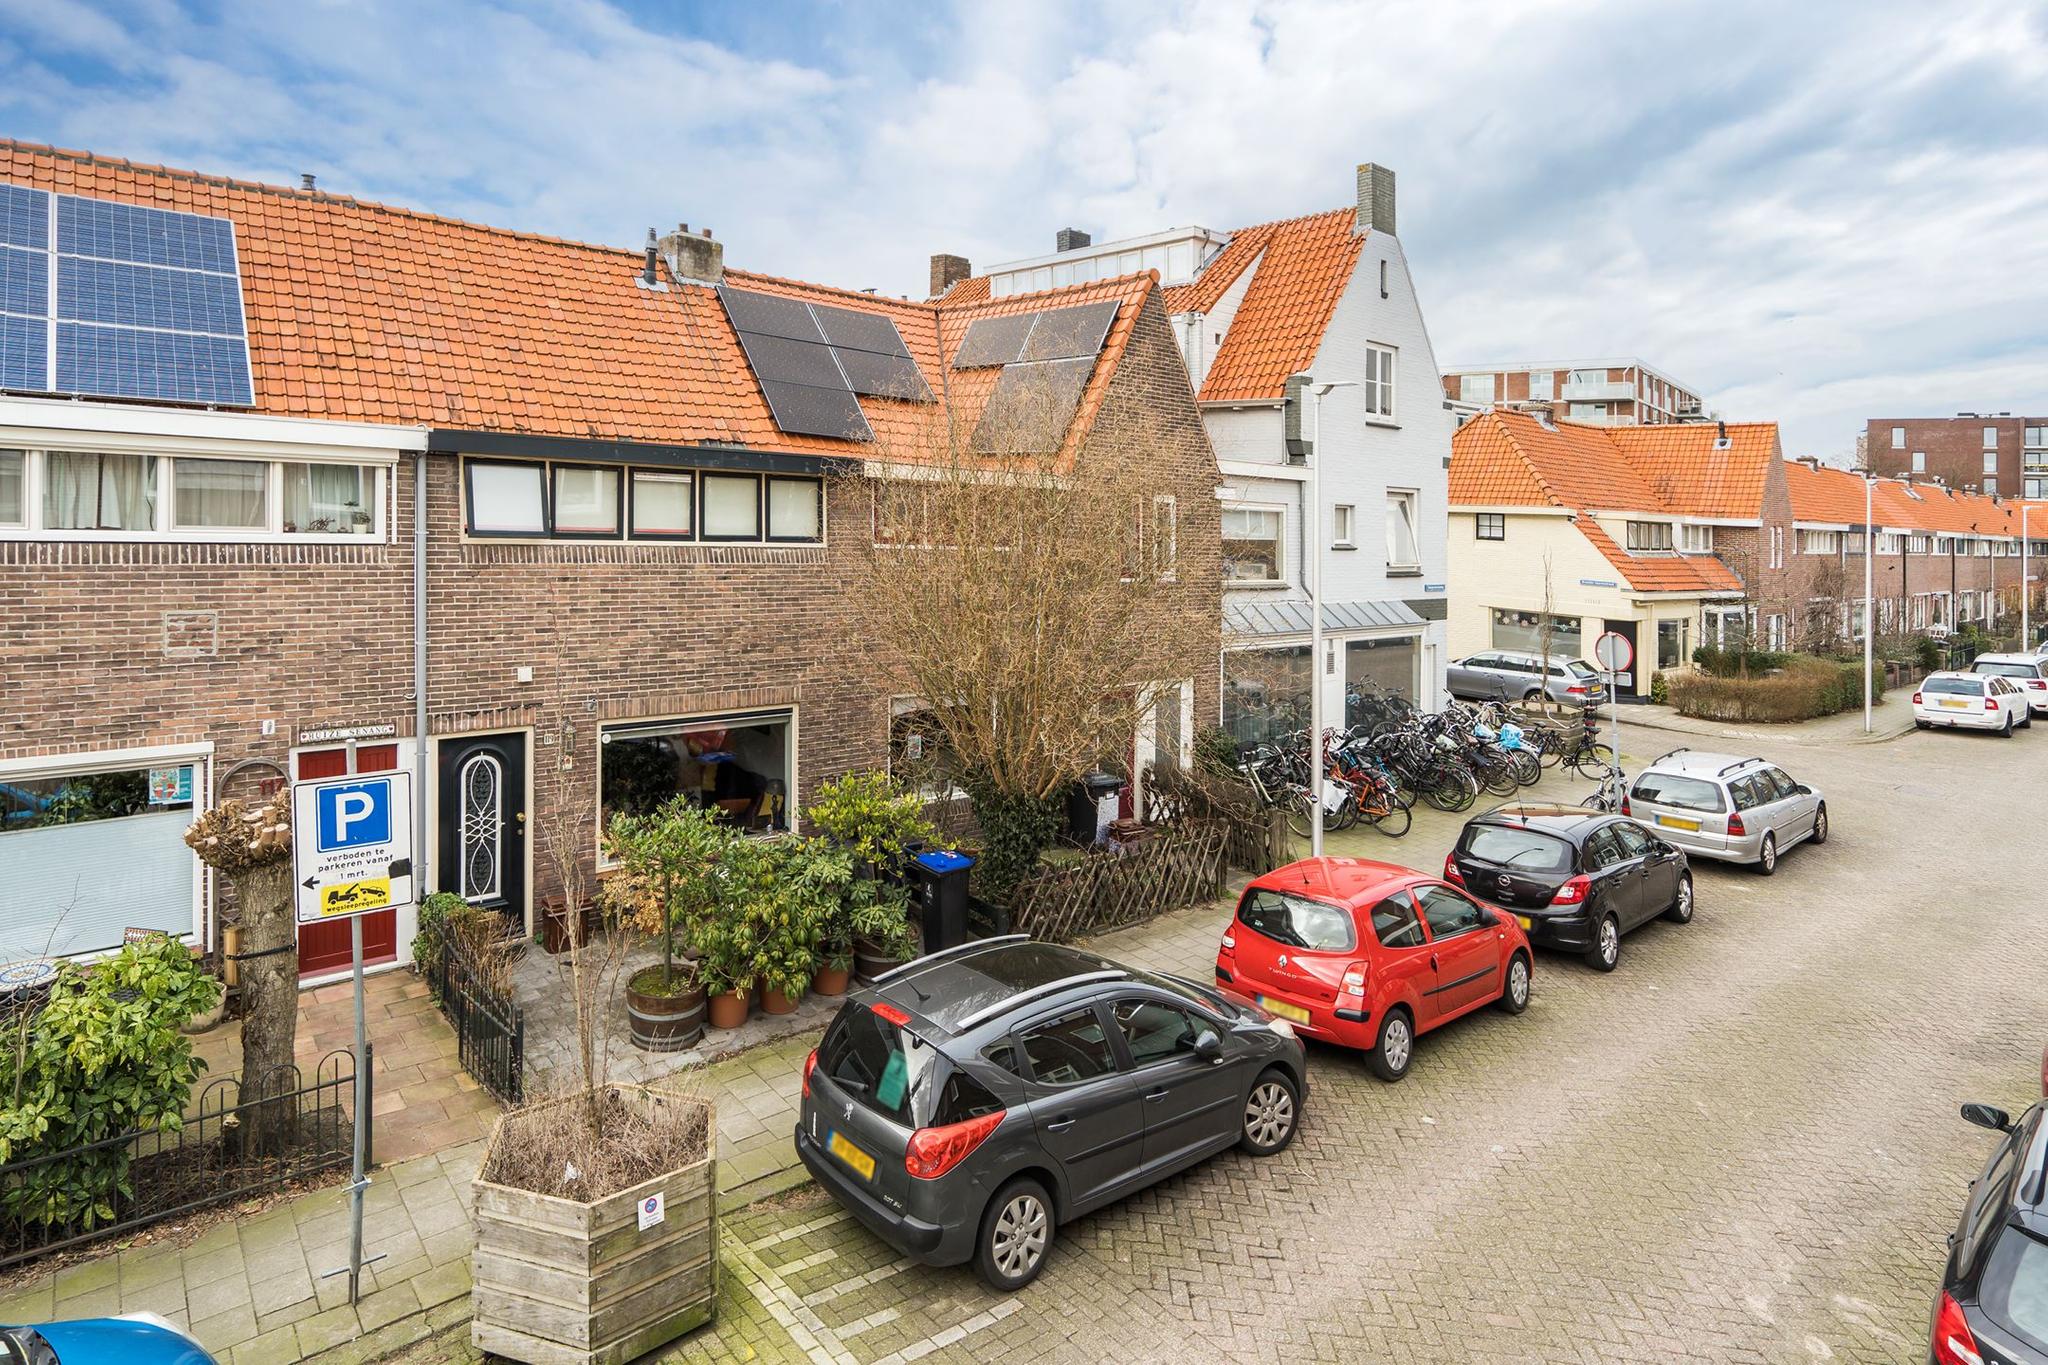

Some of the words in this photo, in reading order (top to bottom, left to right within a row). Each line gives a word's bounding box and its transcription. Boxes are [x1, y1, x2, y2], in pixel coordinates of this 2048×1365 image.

[308, 731, 340, 740] HUIZE
[349, 726, 388, 736] SENANG
[335, 791, 375, 842] P
[318, 860, 363, 873] parkeren
[366, 854, 394, 865] vanaf
[326, 850, 372, 863] verboden
[347, 870, 368, 879] mrt.
[326, 898, 387, 912] wegsleepregeling
[1268, 966, 1297, 979] TWINGO
